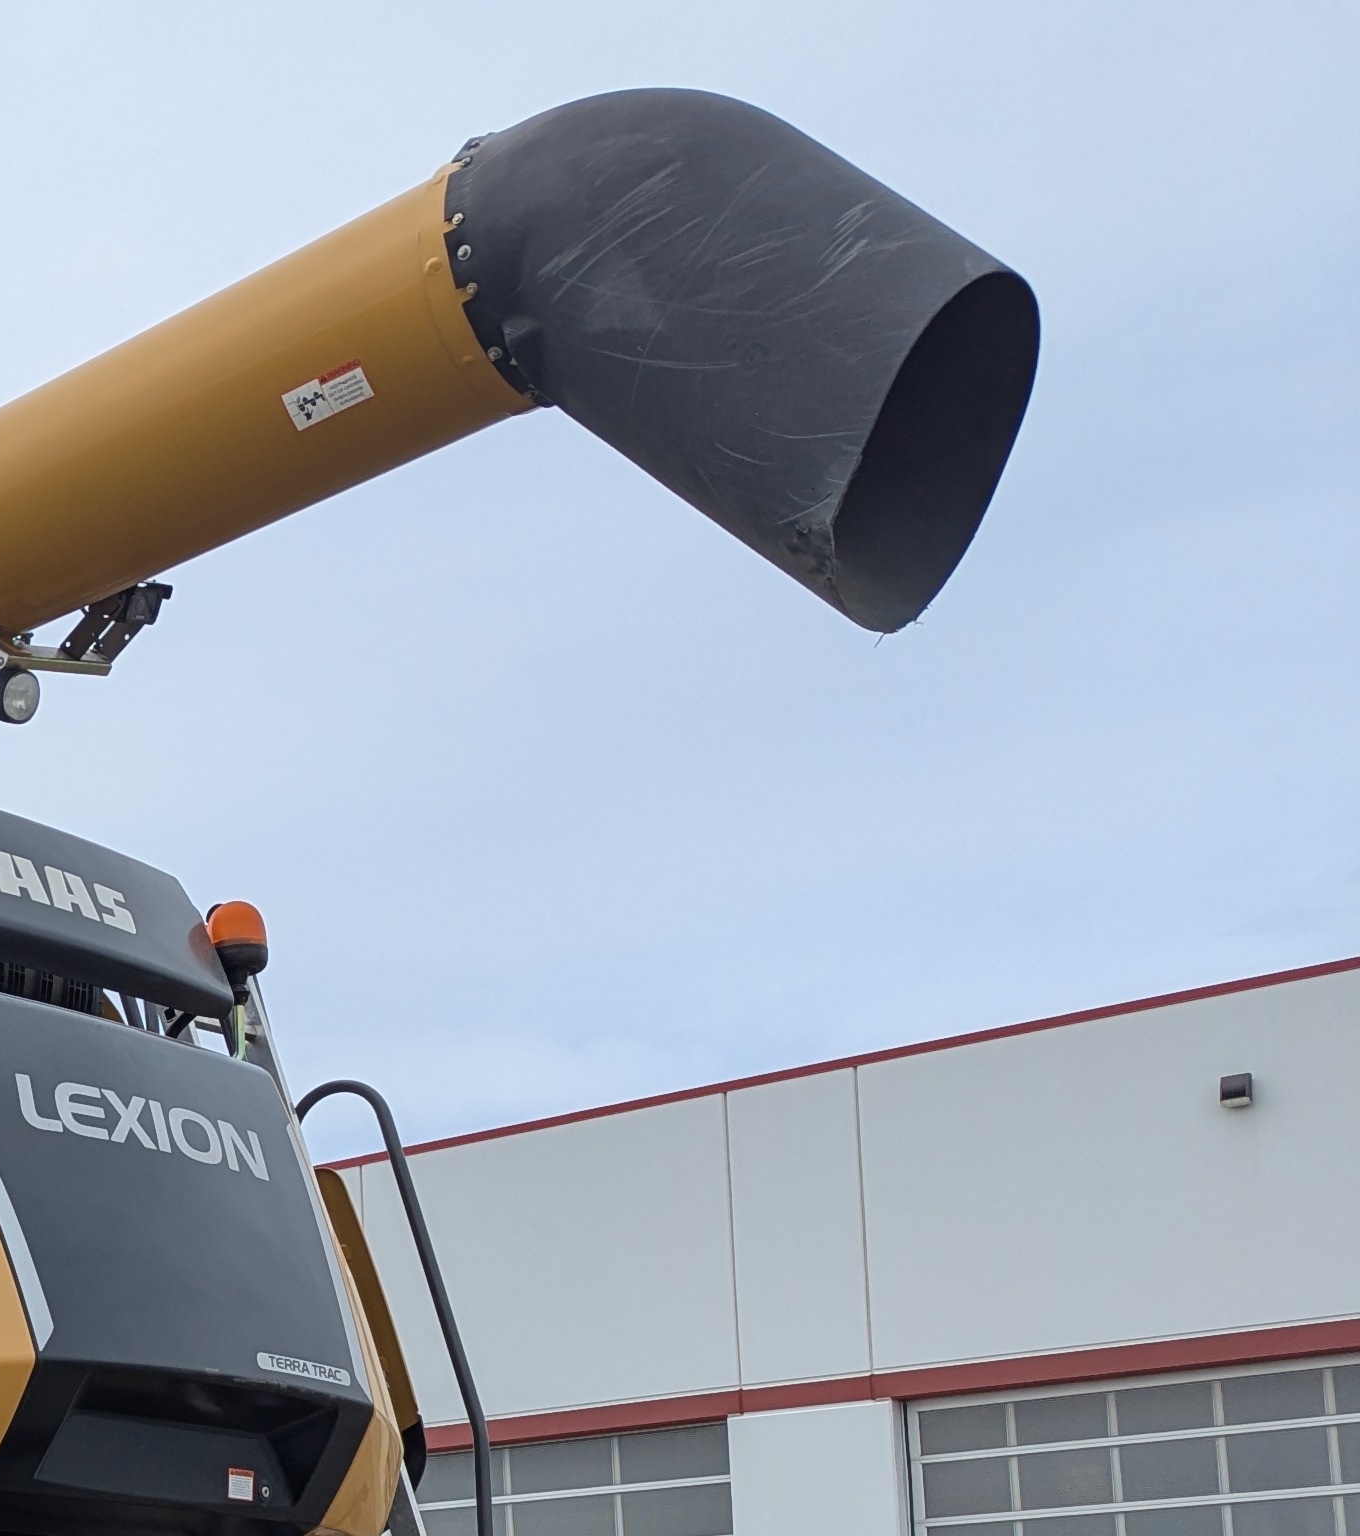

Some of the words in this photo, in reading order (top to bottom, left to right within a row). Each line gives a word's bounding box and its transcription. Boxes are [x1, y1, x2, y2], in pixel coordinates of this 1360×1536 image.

[13, 1072, 271, 1182] LEXION
[268, 1355, 310, 1375] TERRA
[309, 1364, 343, 1382] TRAC
